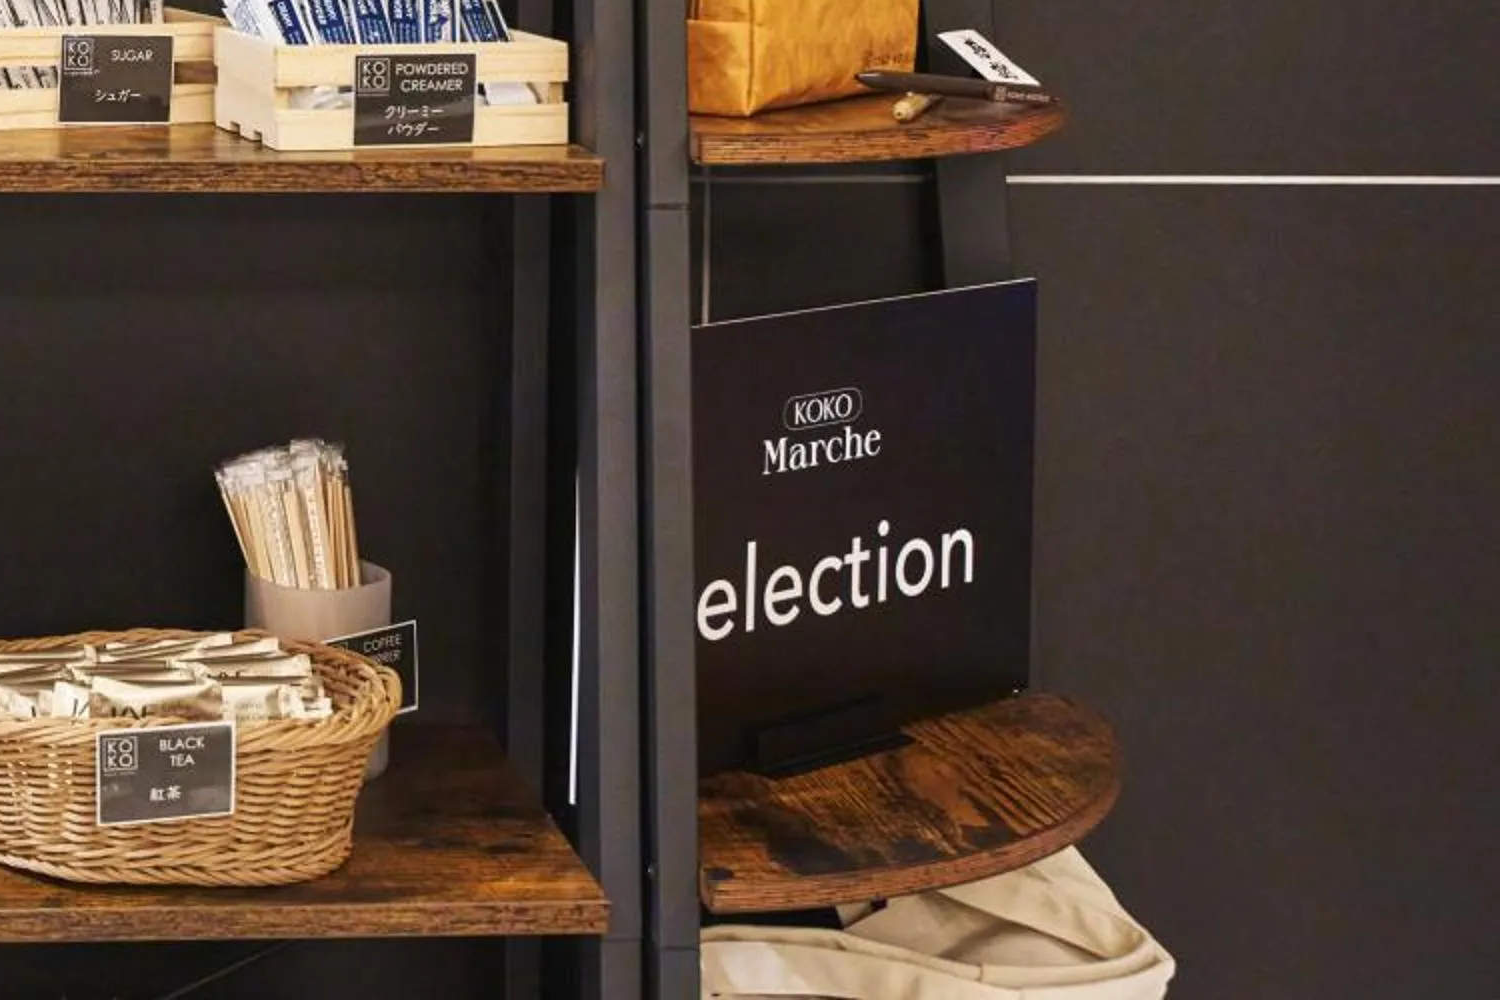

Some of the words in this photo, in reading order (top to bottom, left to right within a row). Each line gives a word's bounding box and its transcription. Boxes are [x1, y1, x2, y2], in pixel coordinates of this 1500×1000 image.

[110, 49, 153, 62] SUGAR
[395, 62, 469, 76] POWDERED
[400, 79, 463, 93] CREAMER
[95, 89, 141, 103] シュガー
[384, 105, 444, 120] クリーミー
[387, 121, 440, 137] パウダー
[794, 393, 853, 425] KOKO
[762, 426, 881, 475] Marche
[696, 519, 975, 642] election
[159, 736, 205, 752] BLACK
[170, 754, 195, 767] TEA
